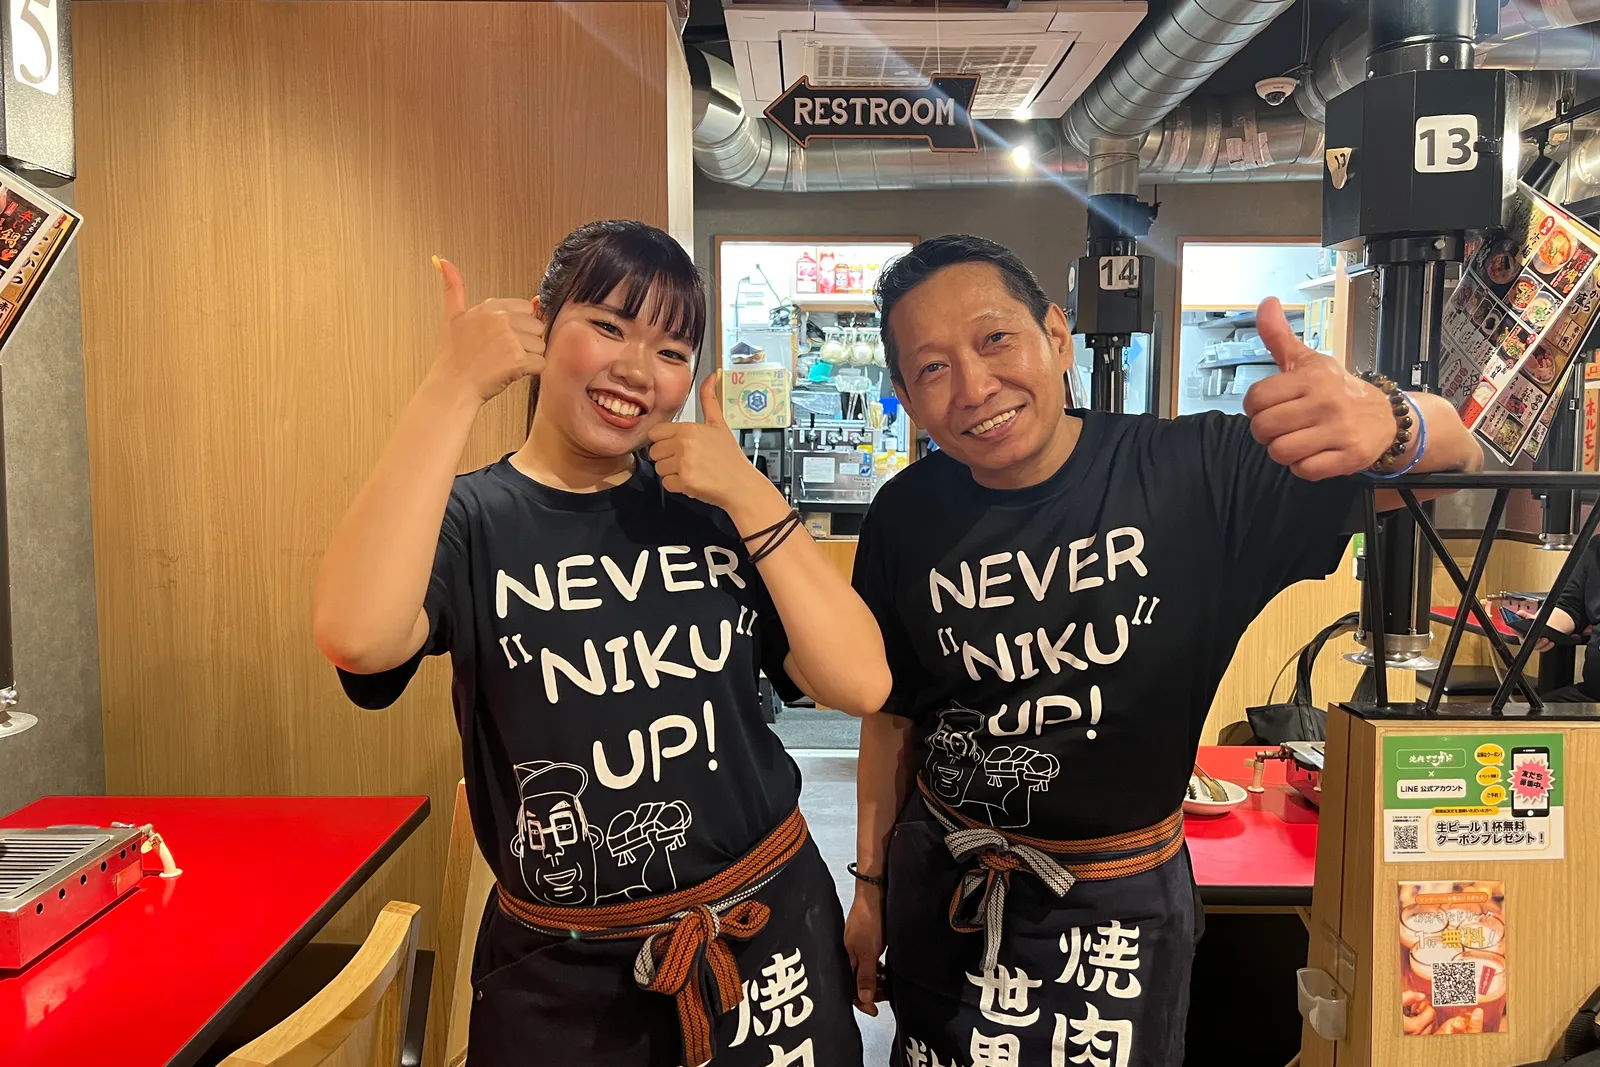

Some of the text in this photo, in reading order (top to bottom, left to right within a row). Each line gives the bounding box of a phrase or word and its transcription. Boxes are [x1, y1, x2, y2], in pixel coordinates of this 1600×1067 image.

[20, 0, 52, 84] 5
[793, 97, 955, 126] RESTROOM
[1418, 127, 1472, 167] 13
[1101, 259, 1138, 286] 14
[1584, 397, 1597, 467] ホルモン
[496, 545, 746, 618] NEVER
[930, 526, 1148, 613] NEVER
[988, 685, 1102, 739] UP!
[592, 700, 718, 790] UP!
[1400, 785, 1463, 793] LINE 公式アカウント
[1522, 770, 1543, 781] 友だち
[1436, 820, 1525, 833] 生ビール1杯無料
[1437, 832, 1545, 845] クーポンプレゼント!
